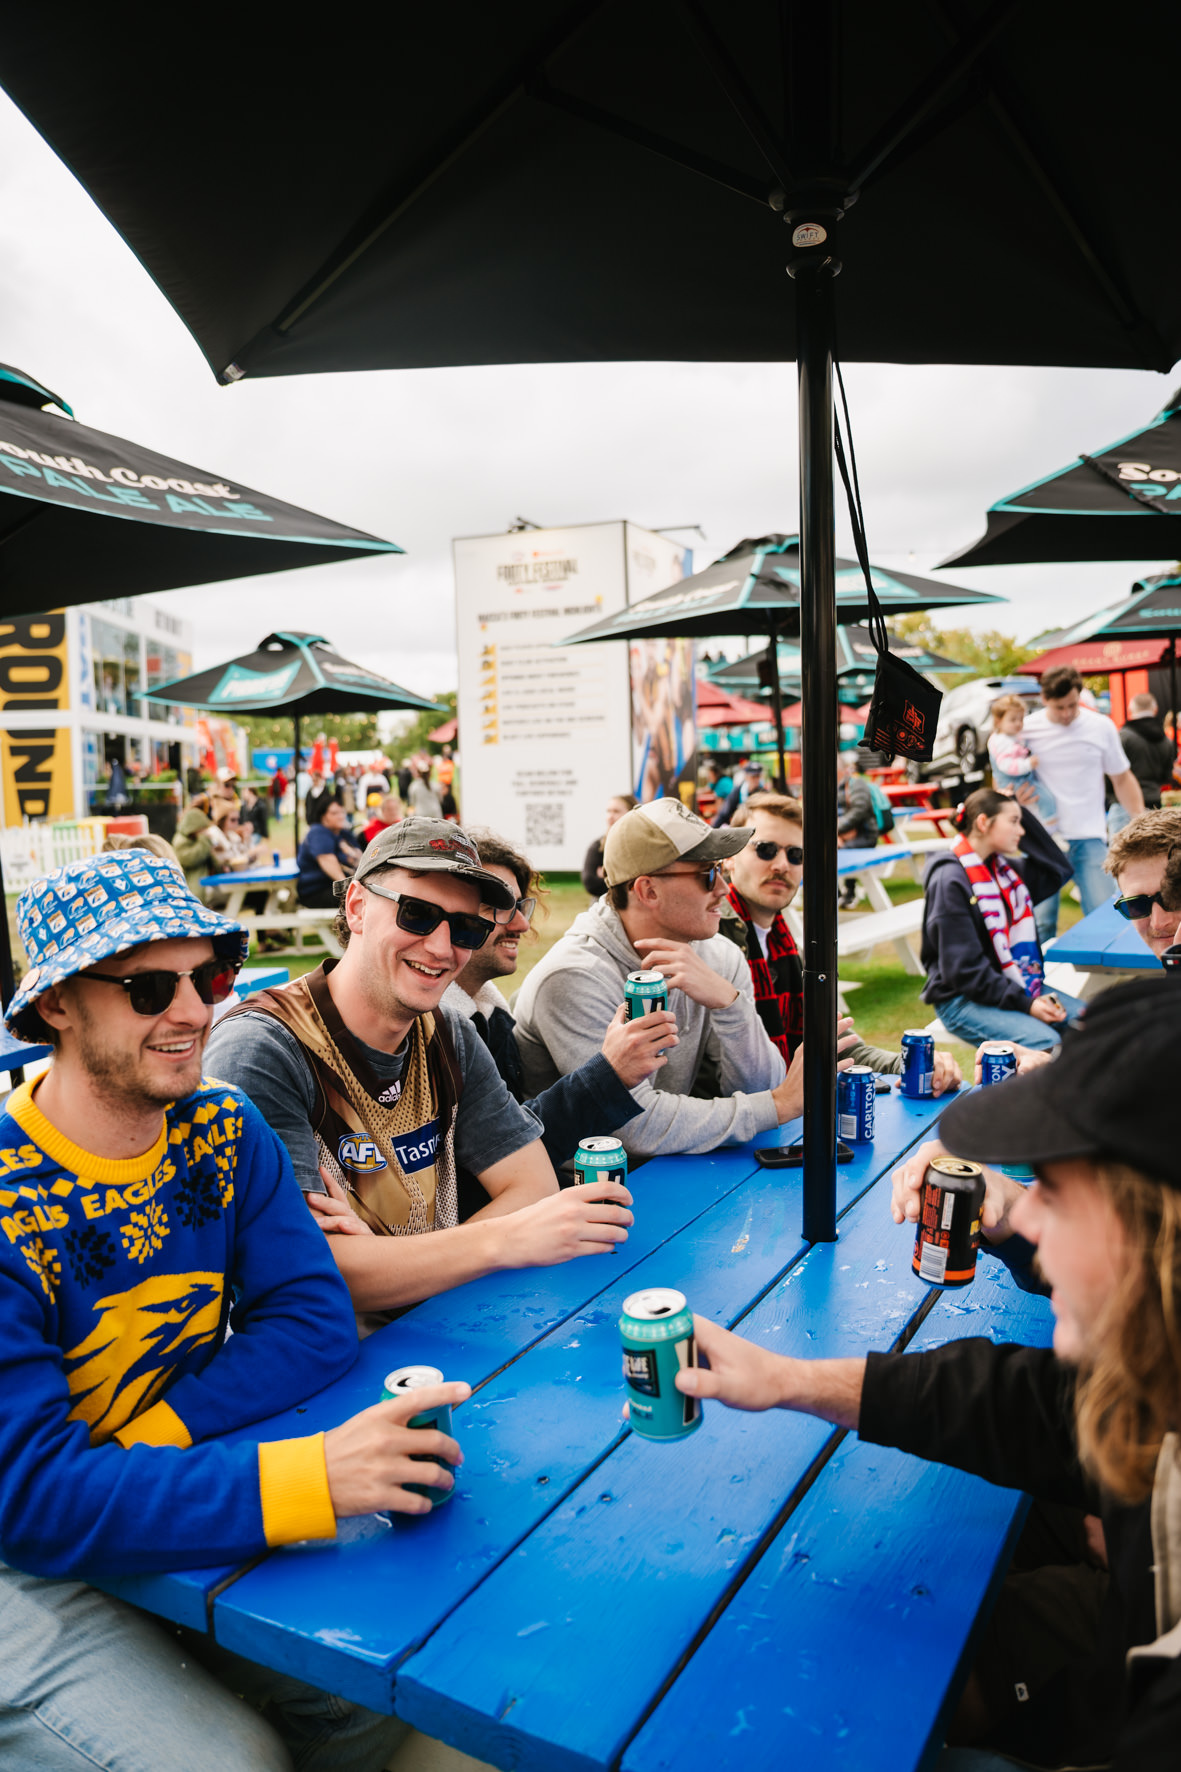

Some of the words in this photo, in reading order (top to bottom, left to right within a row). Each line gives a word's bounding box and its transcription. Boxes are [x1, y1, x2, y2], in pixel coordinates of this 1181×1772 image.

[797, 231, 819, 241] SWIFT
[0, 440, 115, 483] outh
[110, 466, 241, 500] Coast
[0, 453, 161, 511] PALE
[165, 493, 274, 522] ALE
[0, 613, 66, 823] ROUND
[864, 1082, 873, 1139] CARLTON
[342, 1142, 387, 1164] AFL
[80, 1158, 177, 1220] EAGLES
